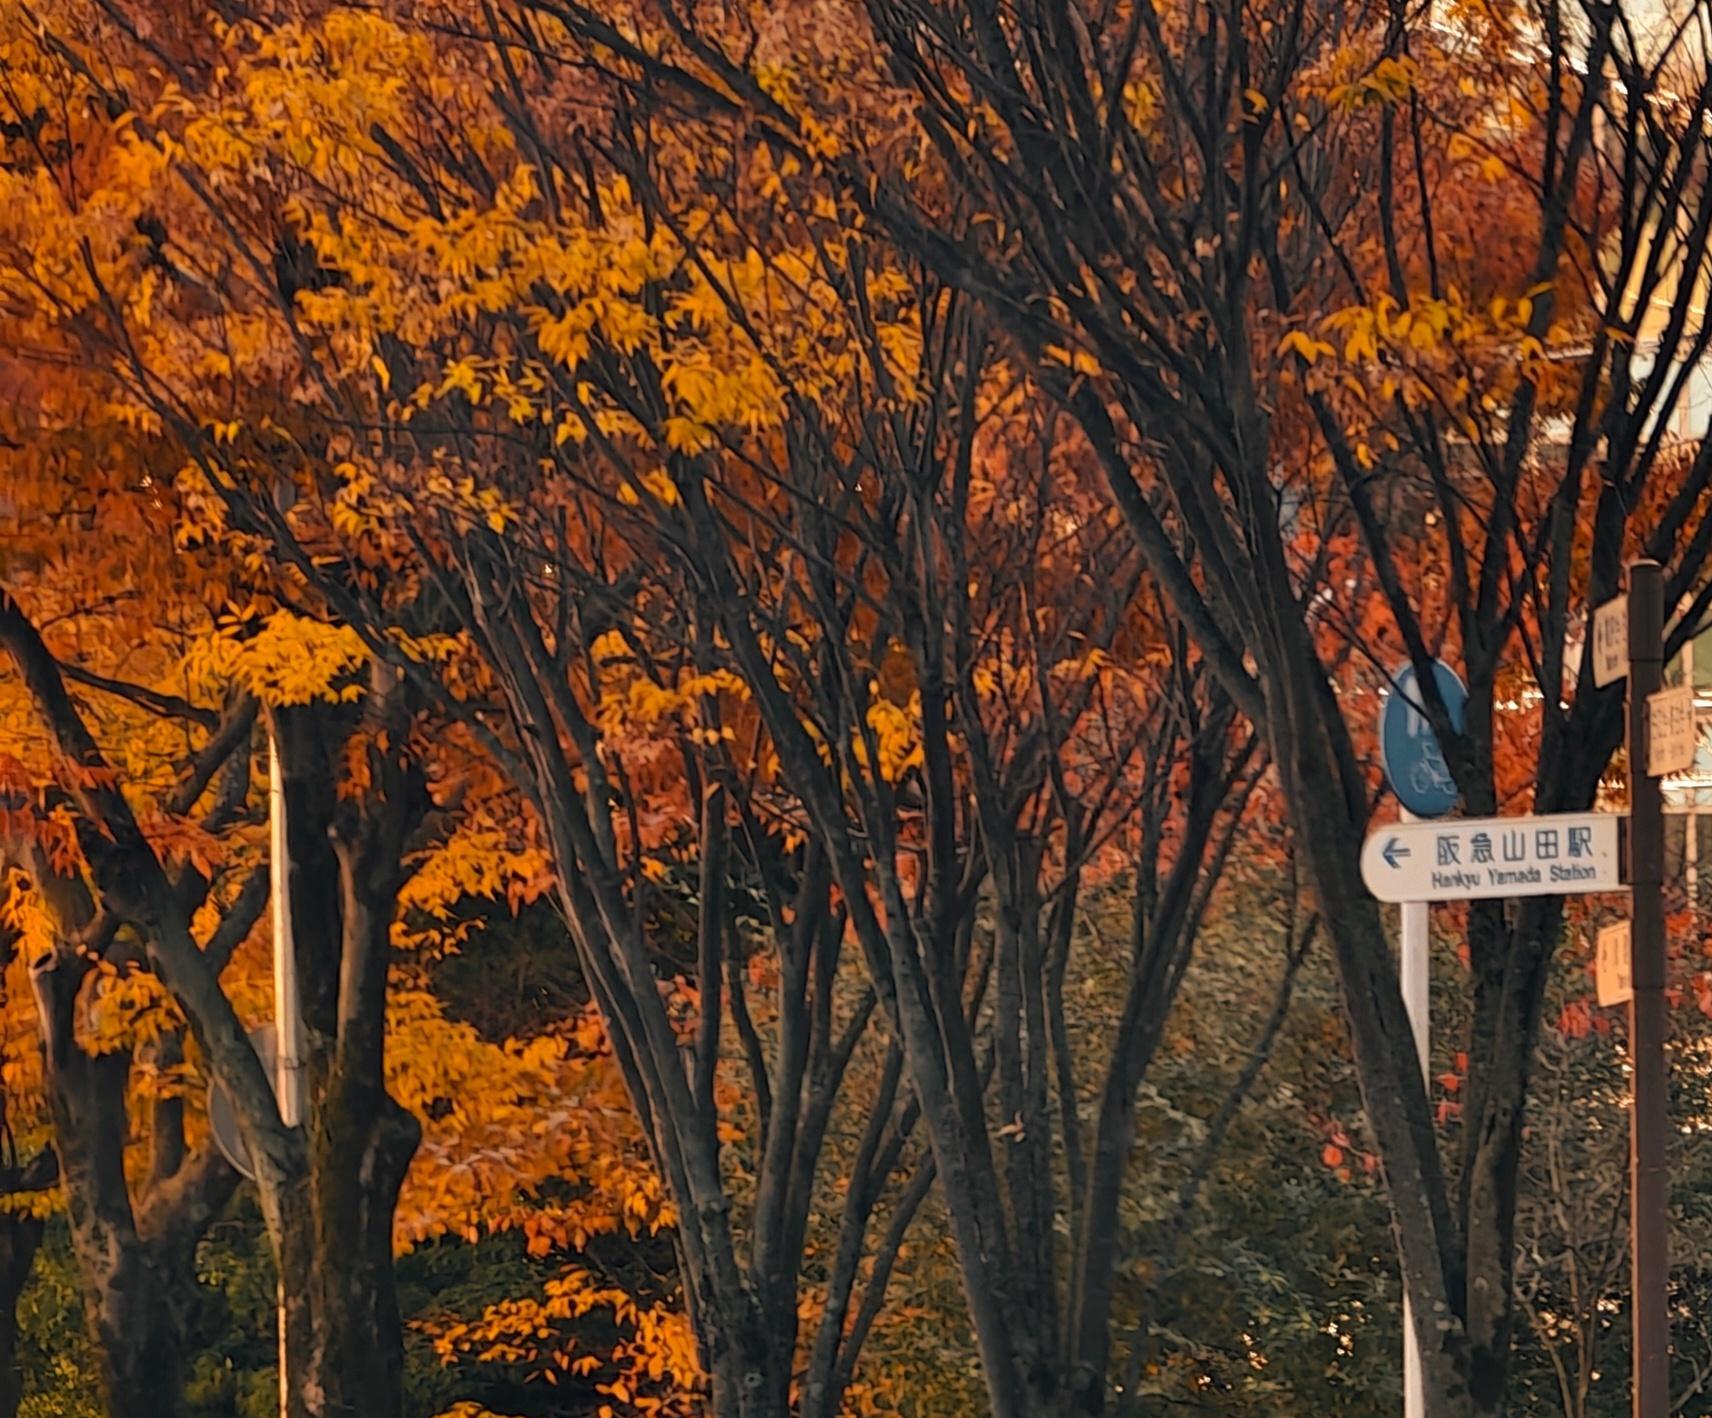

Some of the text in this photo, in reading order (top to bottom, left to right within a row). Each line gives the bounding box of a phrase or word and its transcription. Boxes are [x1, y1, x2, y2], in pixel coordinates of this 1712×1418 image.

[1436, 826, 1593, 866] 阪急山田駅
[1431, 864, 1597, 890] Hankyu Yamada Station
